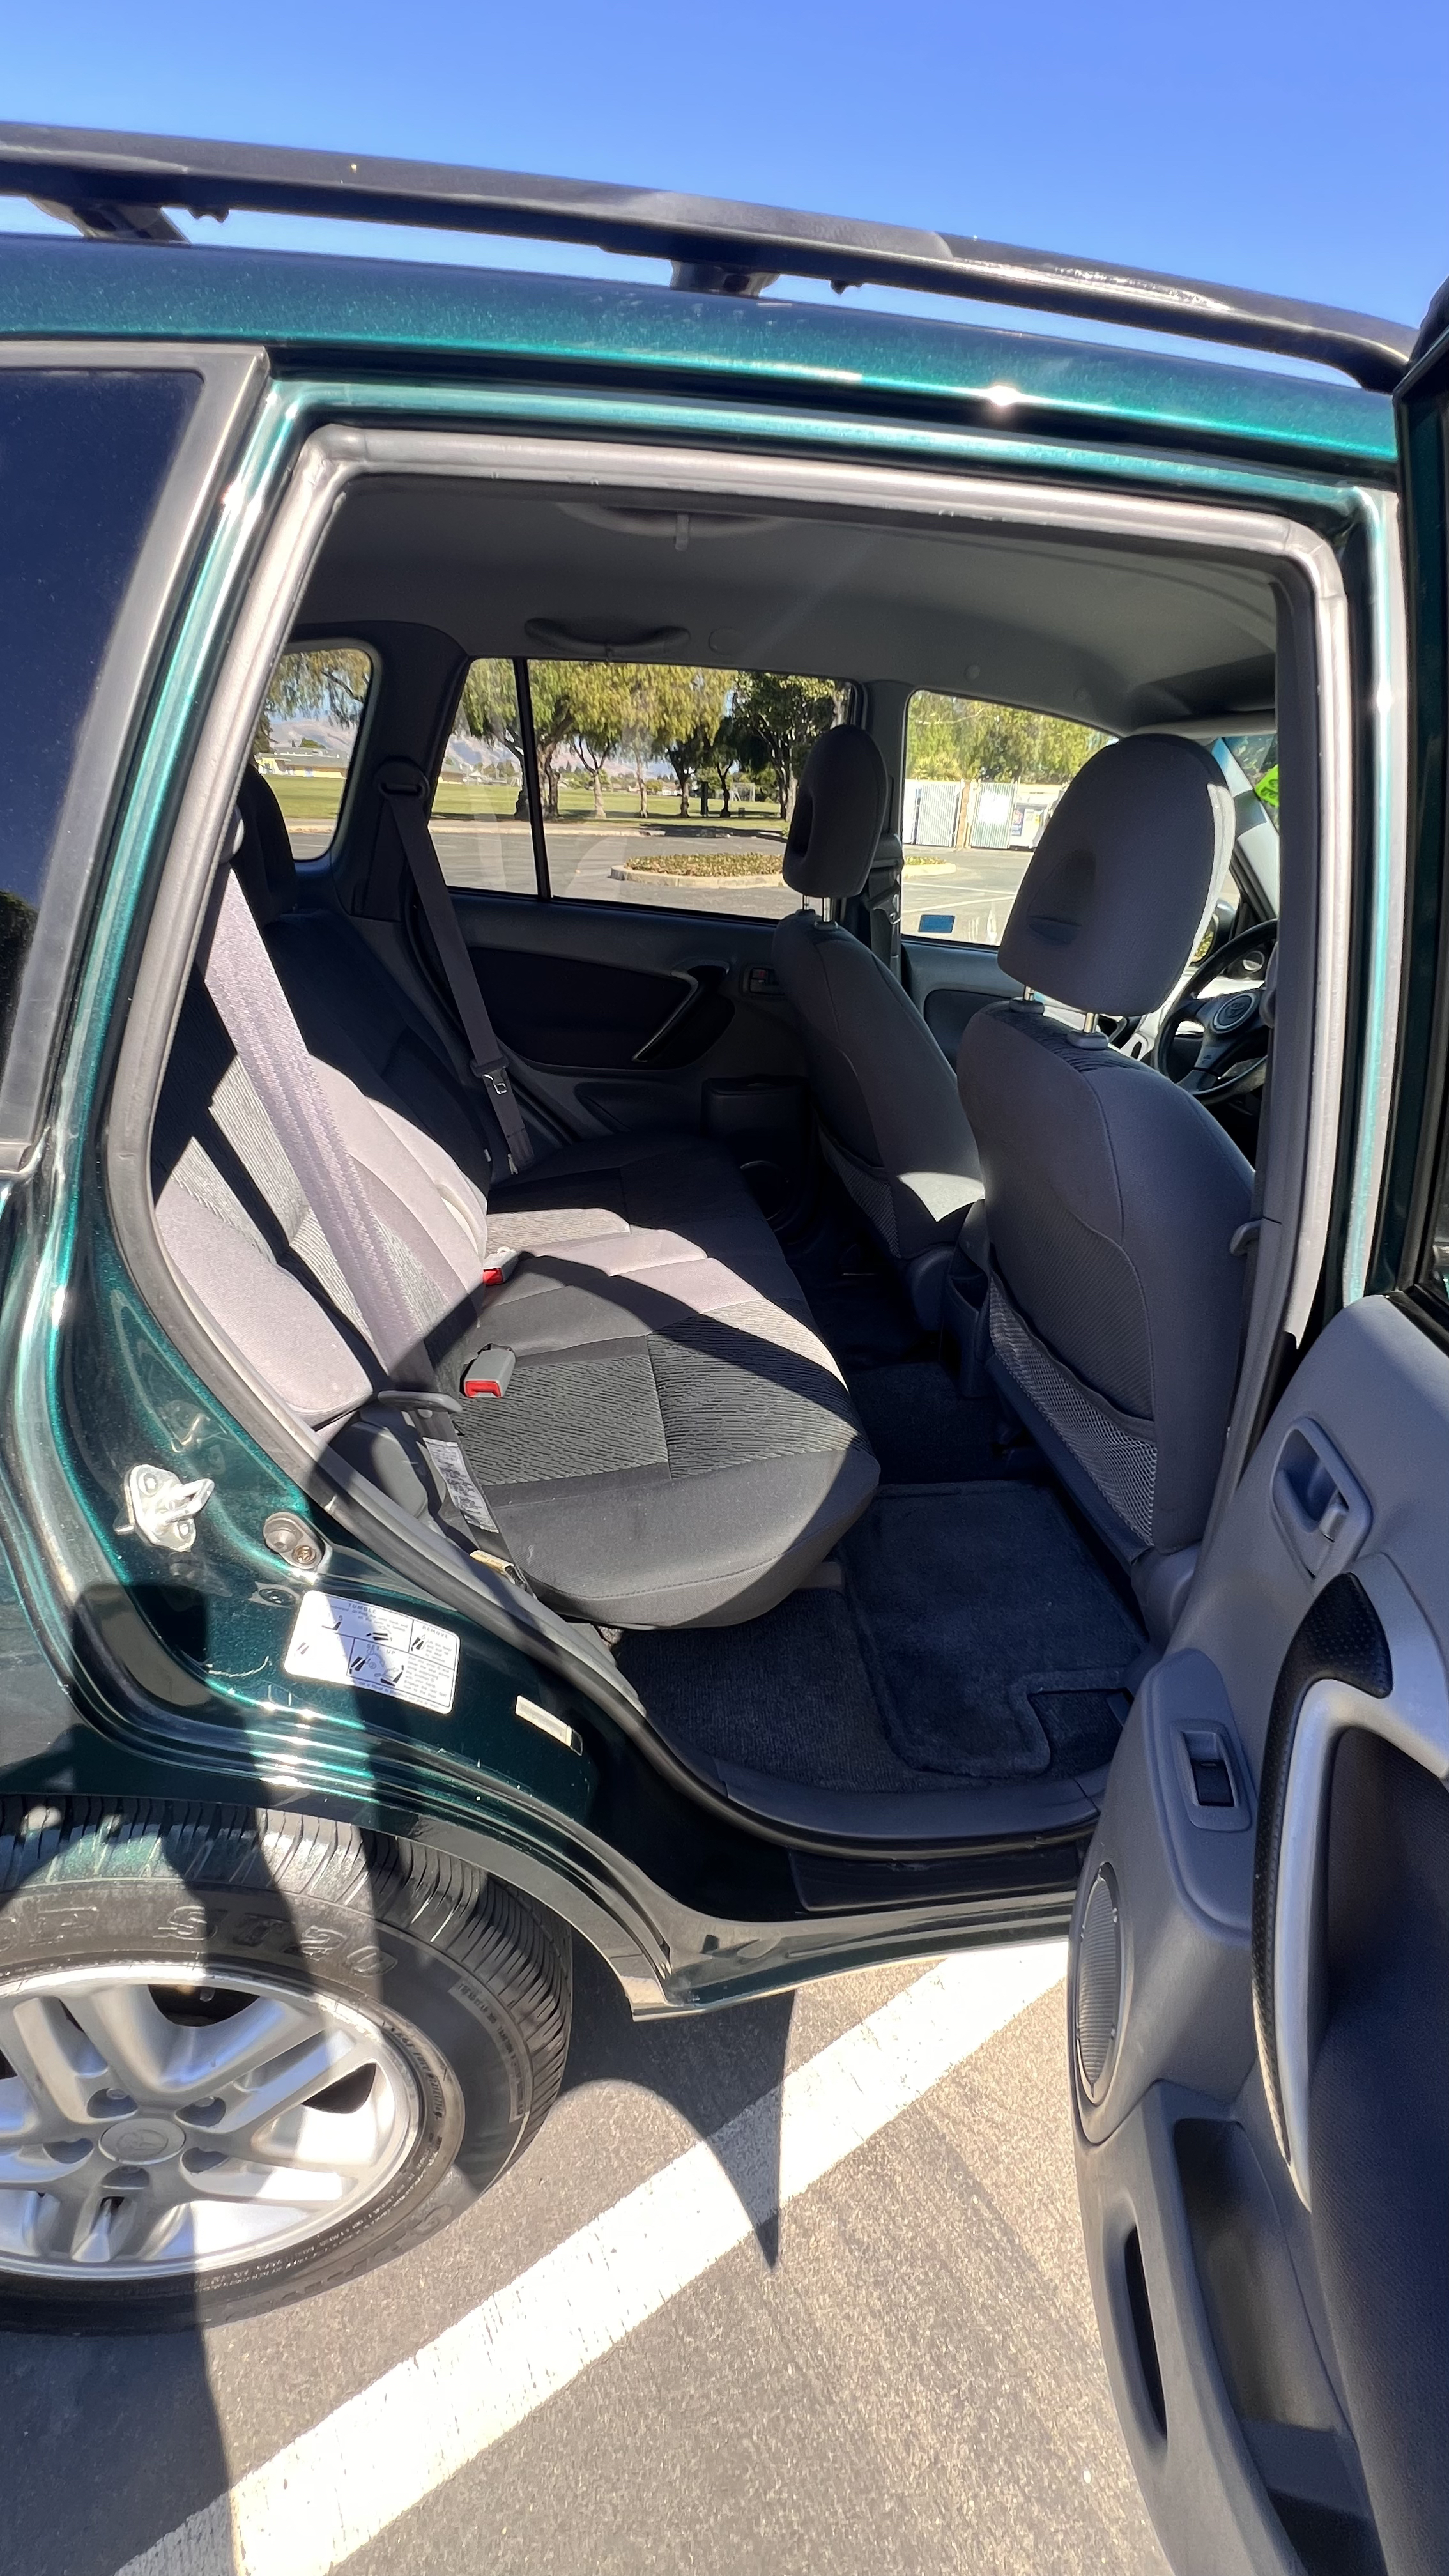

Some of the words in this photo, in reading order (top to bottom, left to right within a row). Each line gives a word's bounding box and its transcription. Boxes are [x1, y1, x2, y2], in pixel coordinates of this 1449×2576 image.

[348, 1602, 376, 1614] TUMBLE
[422, 1625, 448, 1639] REMOVE
[366, 1643, 380, 1652] SET
